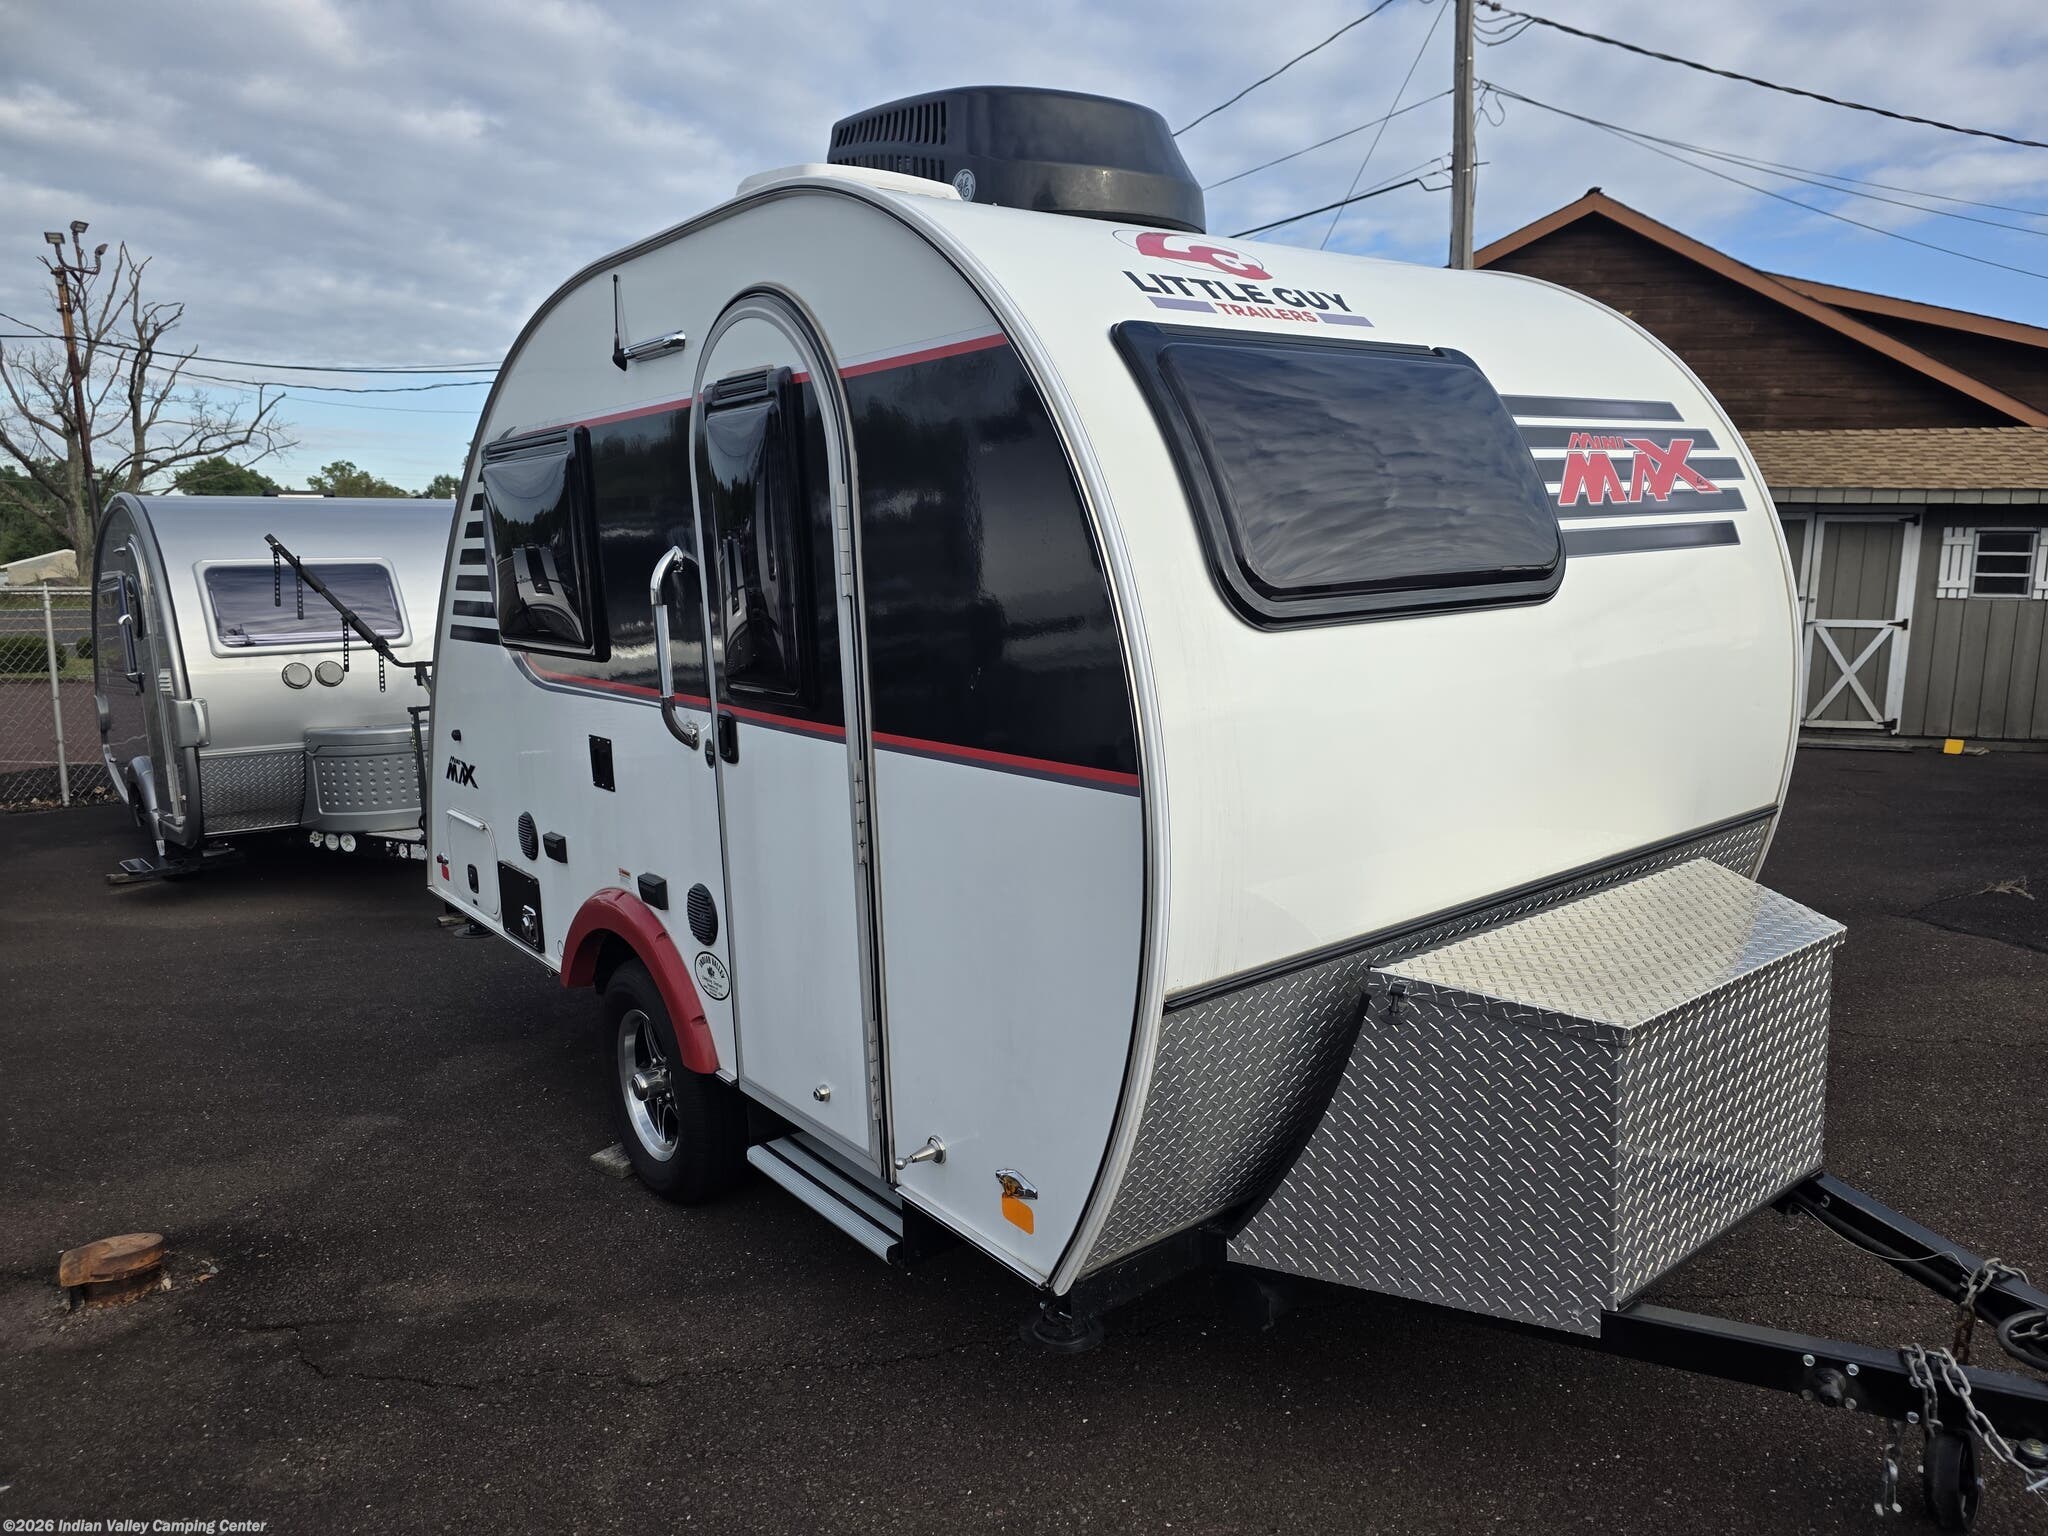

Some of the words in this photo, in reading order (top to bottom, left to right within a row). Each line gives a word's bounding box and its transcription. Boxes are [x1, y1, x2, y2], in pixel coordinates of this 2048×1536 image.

[1122, 270, 1274, 305] LITTLE
[1272, 287, 1352, 312] GUY
[1216, 302, 1318, 323] TRAILERS
[1558, 438, 1722, 506] MAX
[446, 761, 479, 789] MAX
